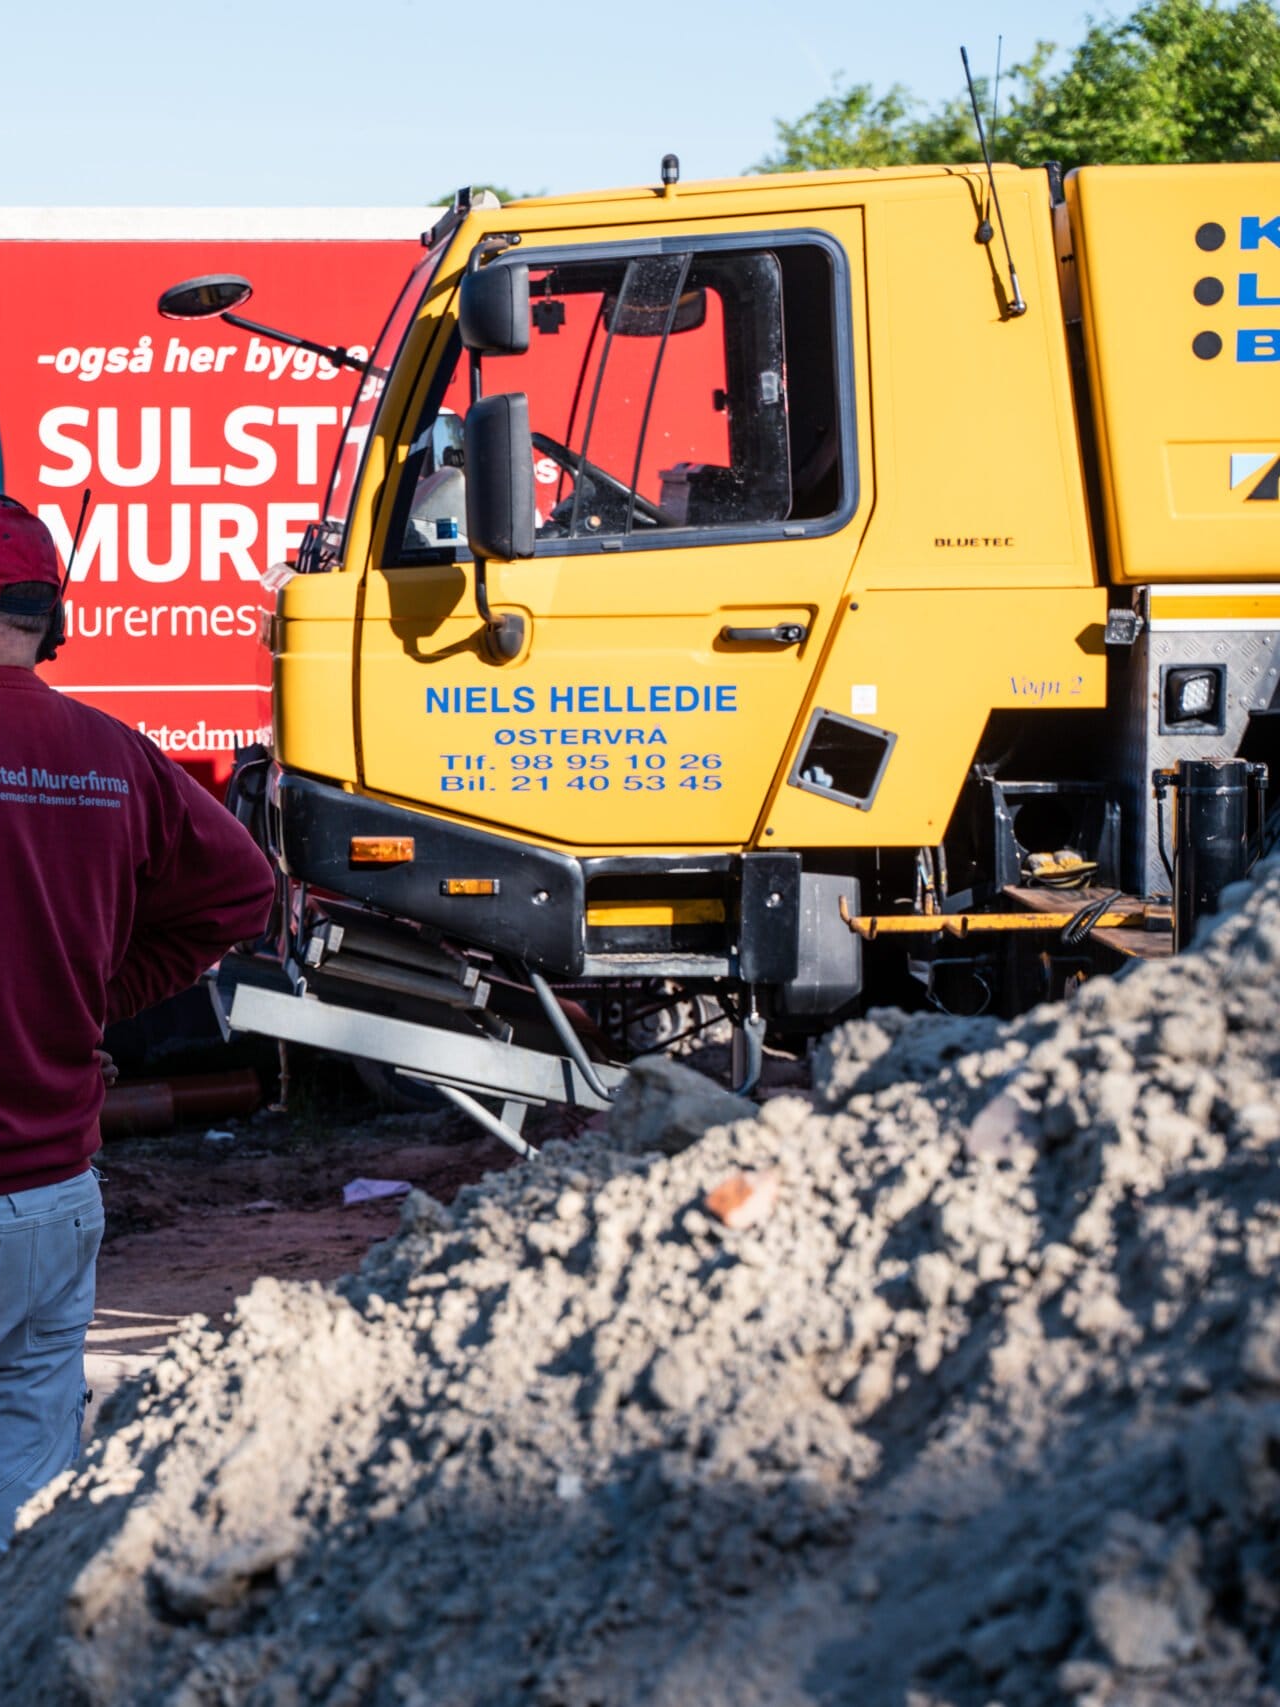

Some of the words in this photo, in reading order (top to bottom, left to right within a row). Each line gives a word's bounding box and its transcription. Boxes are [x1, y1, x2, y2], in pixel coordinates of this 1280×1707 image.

[37, 336, 154, 382] -også
[163, 338, 238, 373] her
[38, 405, 352, 488] SULST
[934, 537, 1015, 547] BLUETEC
[426, 686, 535, 714] NIELS
[550, 684, 738, 713] HELLEDIE
[1010, 675, 1061, 704] Vogn
[1070, 675, 1084, 694] 2
[493, 723, 668, 745] ØSTERVRÅ
[440, 754, 496, 771] Tlf.
[510, 754, 554, 771] 98
[566, 754, 610, 770] 95
[626, 754, 667, 770] 10
[679, 753, 723, 770] 26
[31, 768, 129, 794] Murerfirma
[440, 775, 496, 791] Bil.
[511, 775, 549, 791] 21
[566, 775, 610, 791] 40
[623, 775, 667, 791] 53
[678, 775, 723, 791] 45
[39, 793, 76, 806] Rasmus
[78, 795, 121, 808] Sørensen
